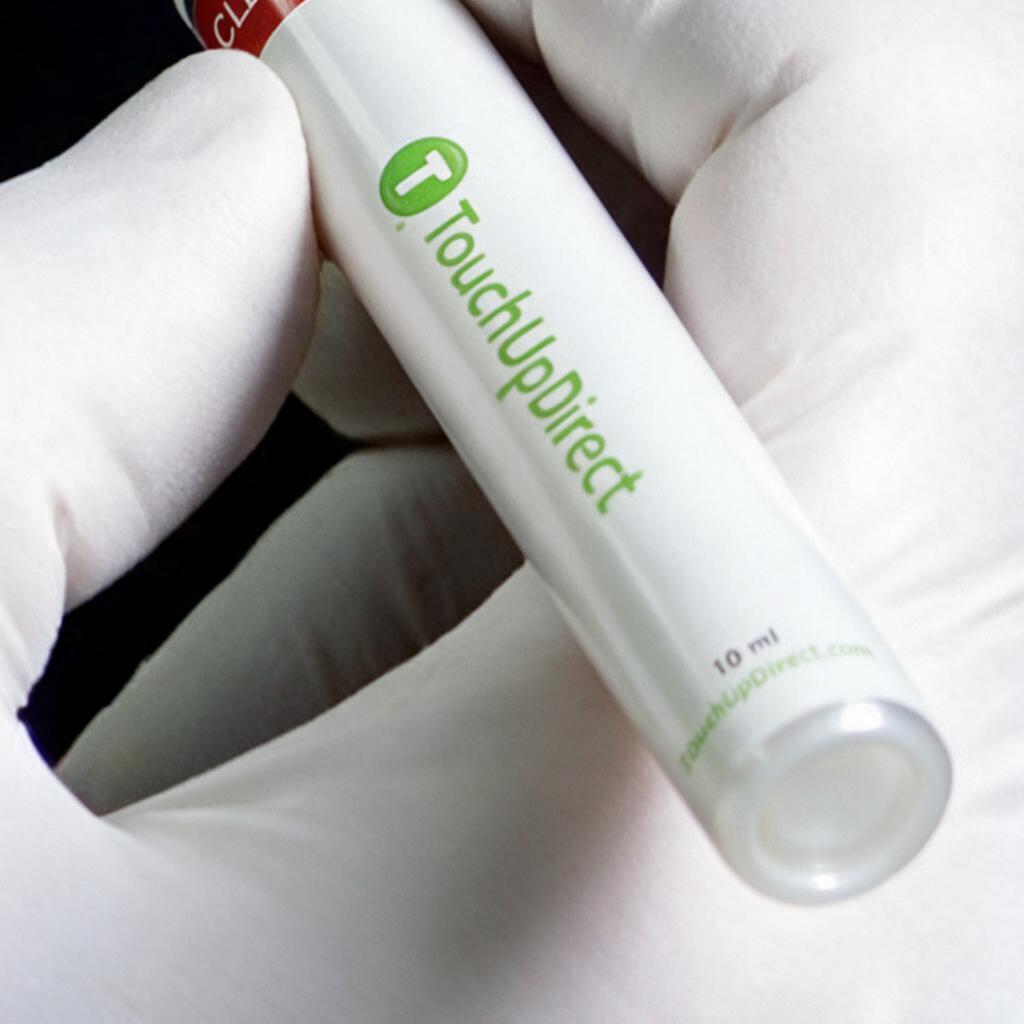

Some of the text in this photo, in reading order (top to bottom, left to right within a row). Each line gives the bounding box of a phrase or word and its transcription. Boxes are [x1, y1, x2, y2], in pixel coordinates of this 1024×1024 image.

[424, 198, 644, 515] TouchUpDirect
[713, 628, 779, 675] 10 ml
